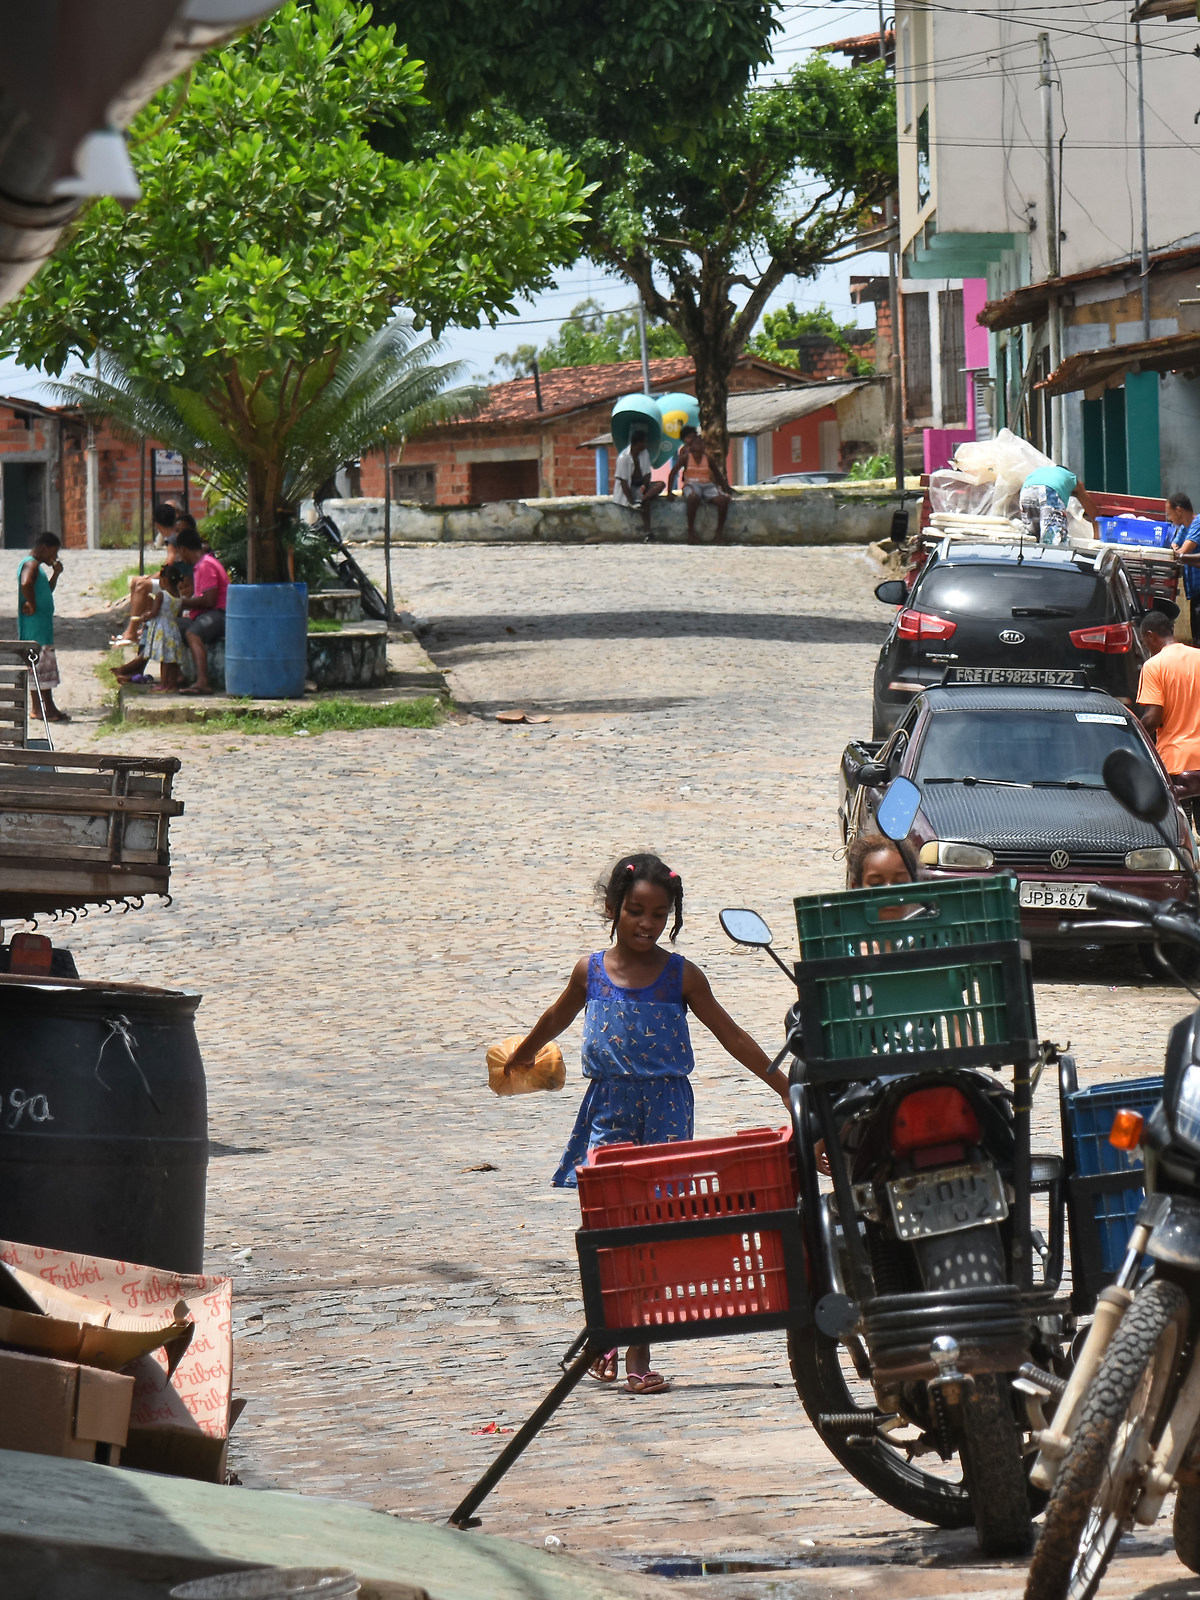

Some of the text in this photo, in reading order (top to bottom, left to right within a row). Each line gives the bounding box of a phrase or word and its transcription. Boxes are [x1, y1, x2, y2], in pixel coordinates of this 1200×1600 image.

[0, 1087, 55, 1129] ga
[40, 1260, 105, 1290] Friboi
[121, 1274, 186, 1309] Friboi
[172, 1359, 230, 1389] Friboi
[130, 1402, 178, 1424] riboi
